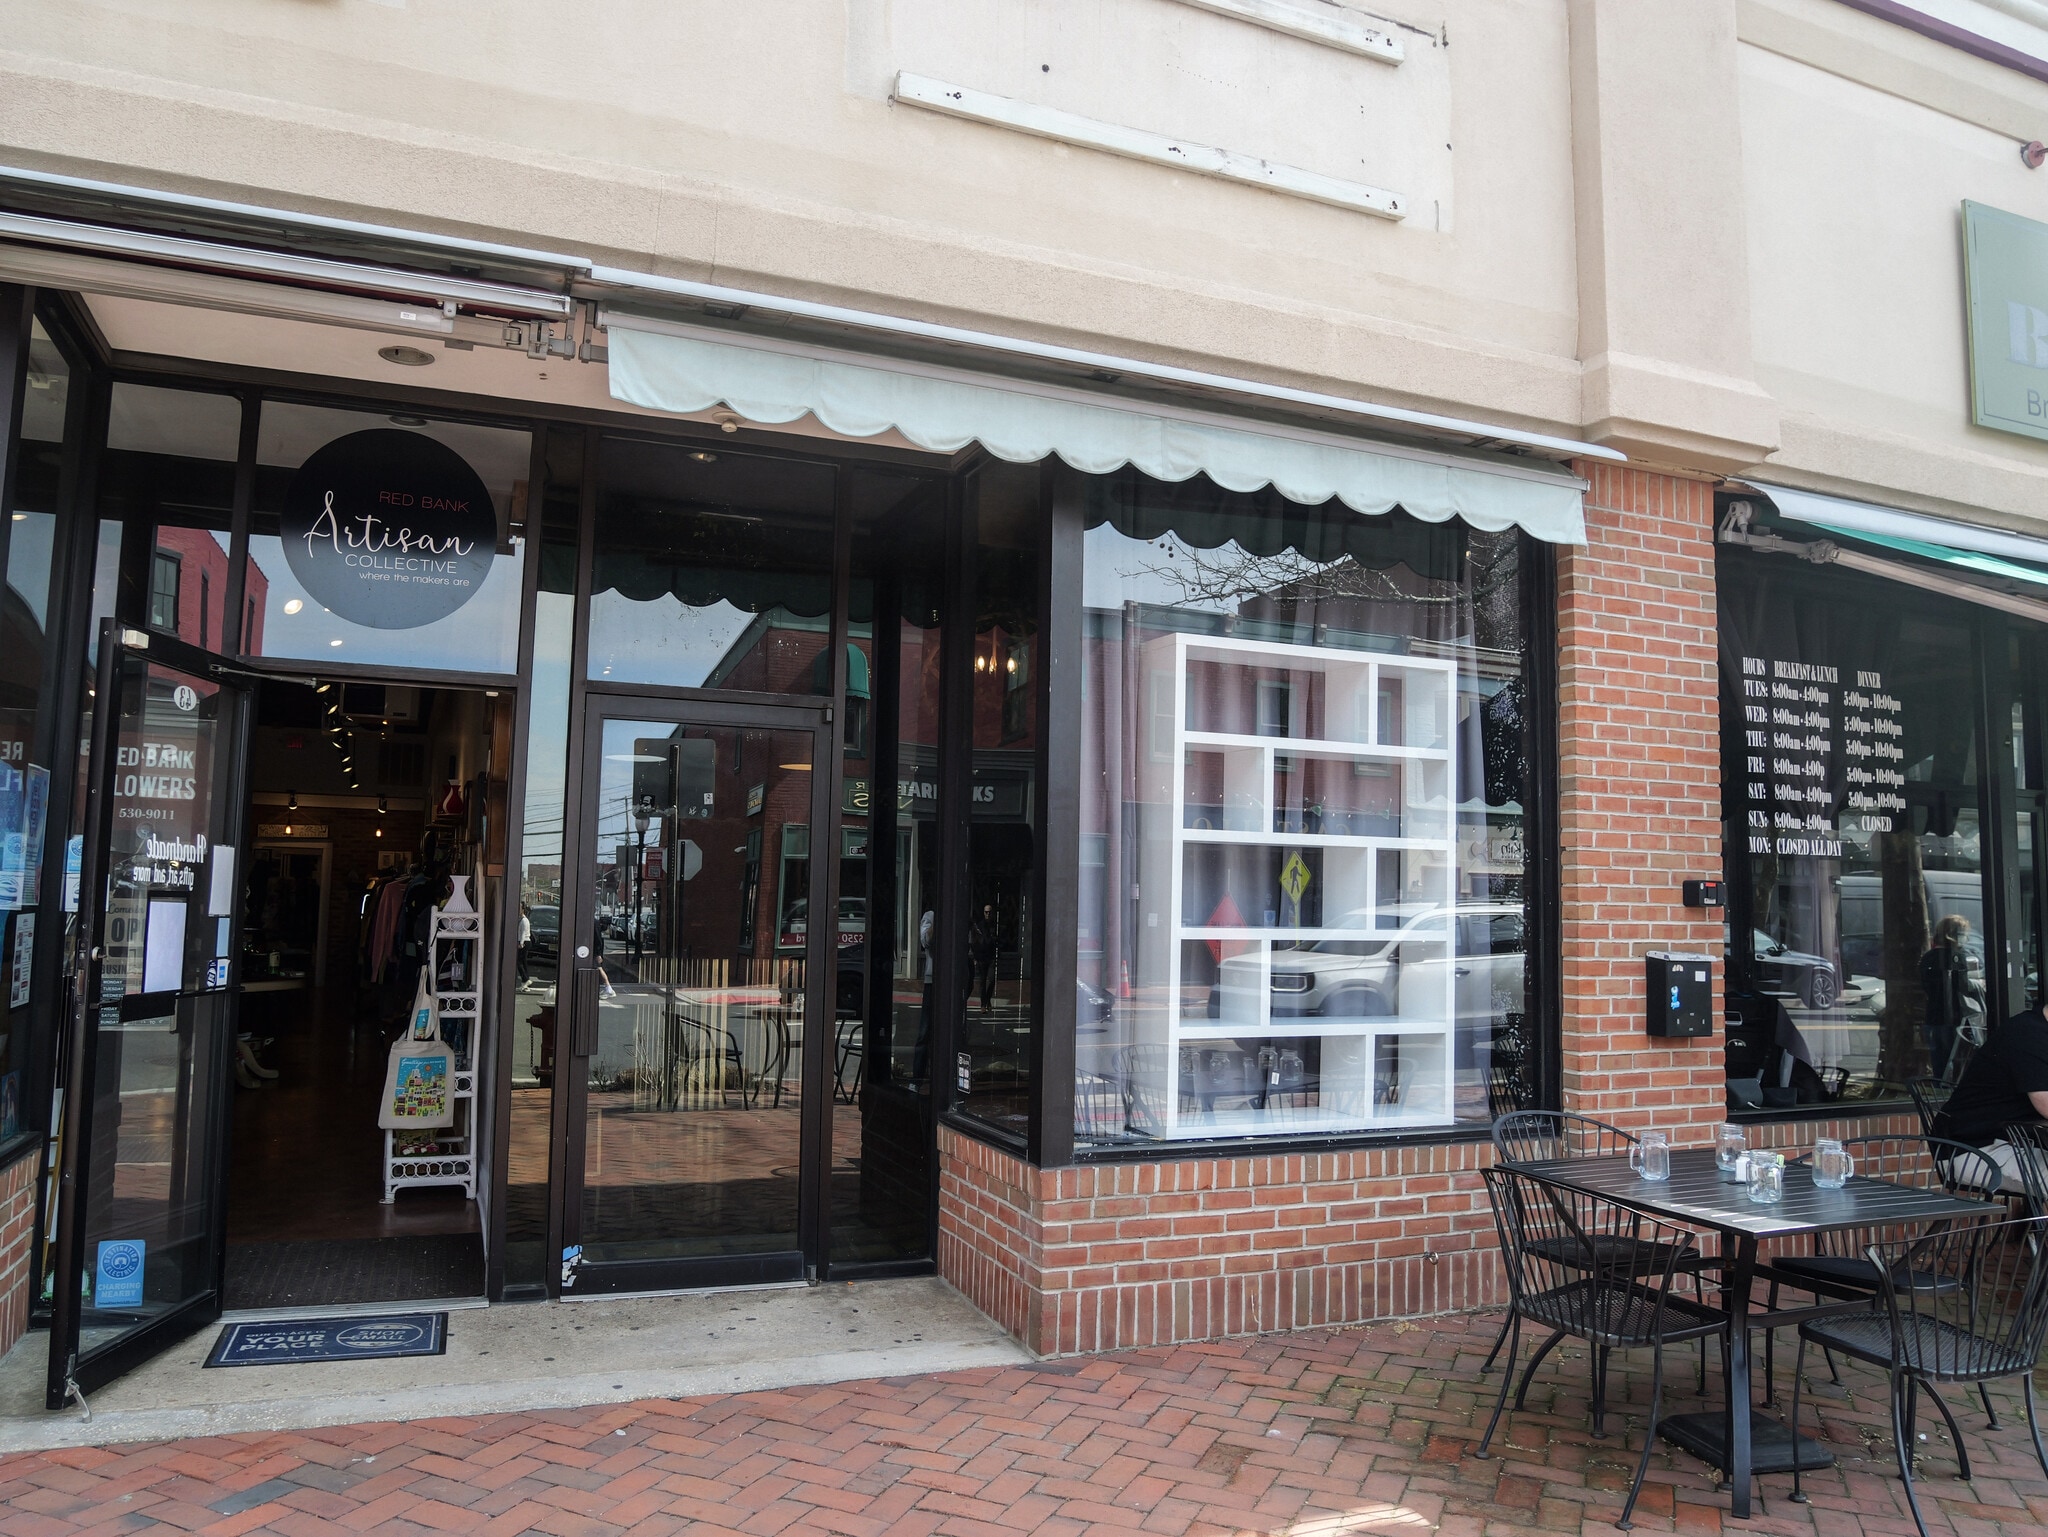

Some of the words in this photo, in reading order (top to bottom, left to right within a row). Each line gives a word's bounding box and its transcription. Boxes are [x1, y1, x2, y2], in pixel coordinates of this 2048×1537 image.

[379, 491, 414, 506] RED
[421, 496, 470, 513] BANK
[303, 490, 474, 558] Artisan
[345, 553, 458, 574] COLLECTIVE
[359, 571, 390, 581] where
[394, 574, 410, 583] the
[412, 575, 450, 585] makers
[453, 578, 470, 587] are
[1743, 657, 1766, 676] HOURS
[1774, 660, 1811, 680] BREAKFAST
[1817, 665, 1838, 683] LUNCH
[1857, 670, 1881, 688] DINNER
[1744, 679, 1768, 697] TUES:
[1745, 705, 1767, 722] WED:
[1746, 730, 1766, 747] THU:
[145, 749, 195, 769] BANK
[1747, 756, 1765, 773] FRI:
[114, 774, 197, 800] LOWERS
[1748, 782, 1766, 799] SAT:
[1748, 810, 1768, 828] SUN:
[1861, 815, 1892, 832] CLOSED
[1749, 836, 1771, 853] MON:
[1776, 838, 1809, 855] CLOSED
[1810, 839, 1826, 856] ALL
[1827, 840, 1842, 856] DAY
[105, 1265, 136, 1278] ELECTRIC
[98, 1281, 141, 1290] CHARGING
[101, 1290, 137, 1298] NEARBY
[239, 1340, 324, 1351] PLACE
[245, 1334, 325, 1344] YOUR
